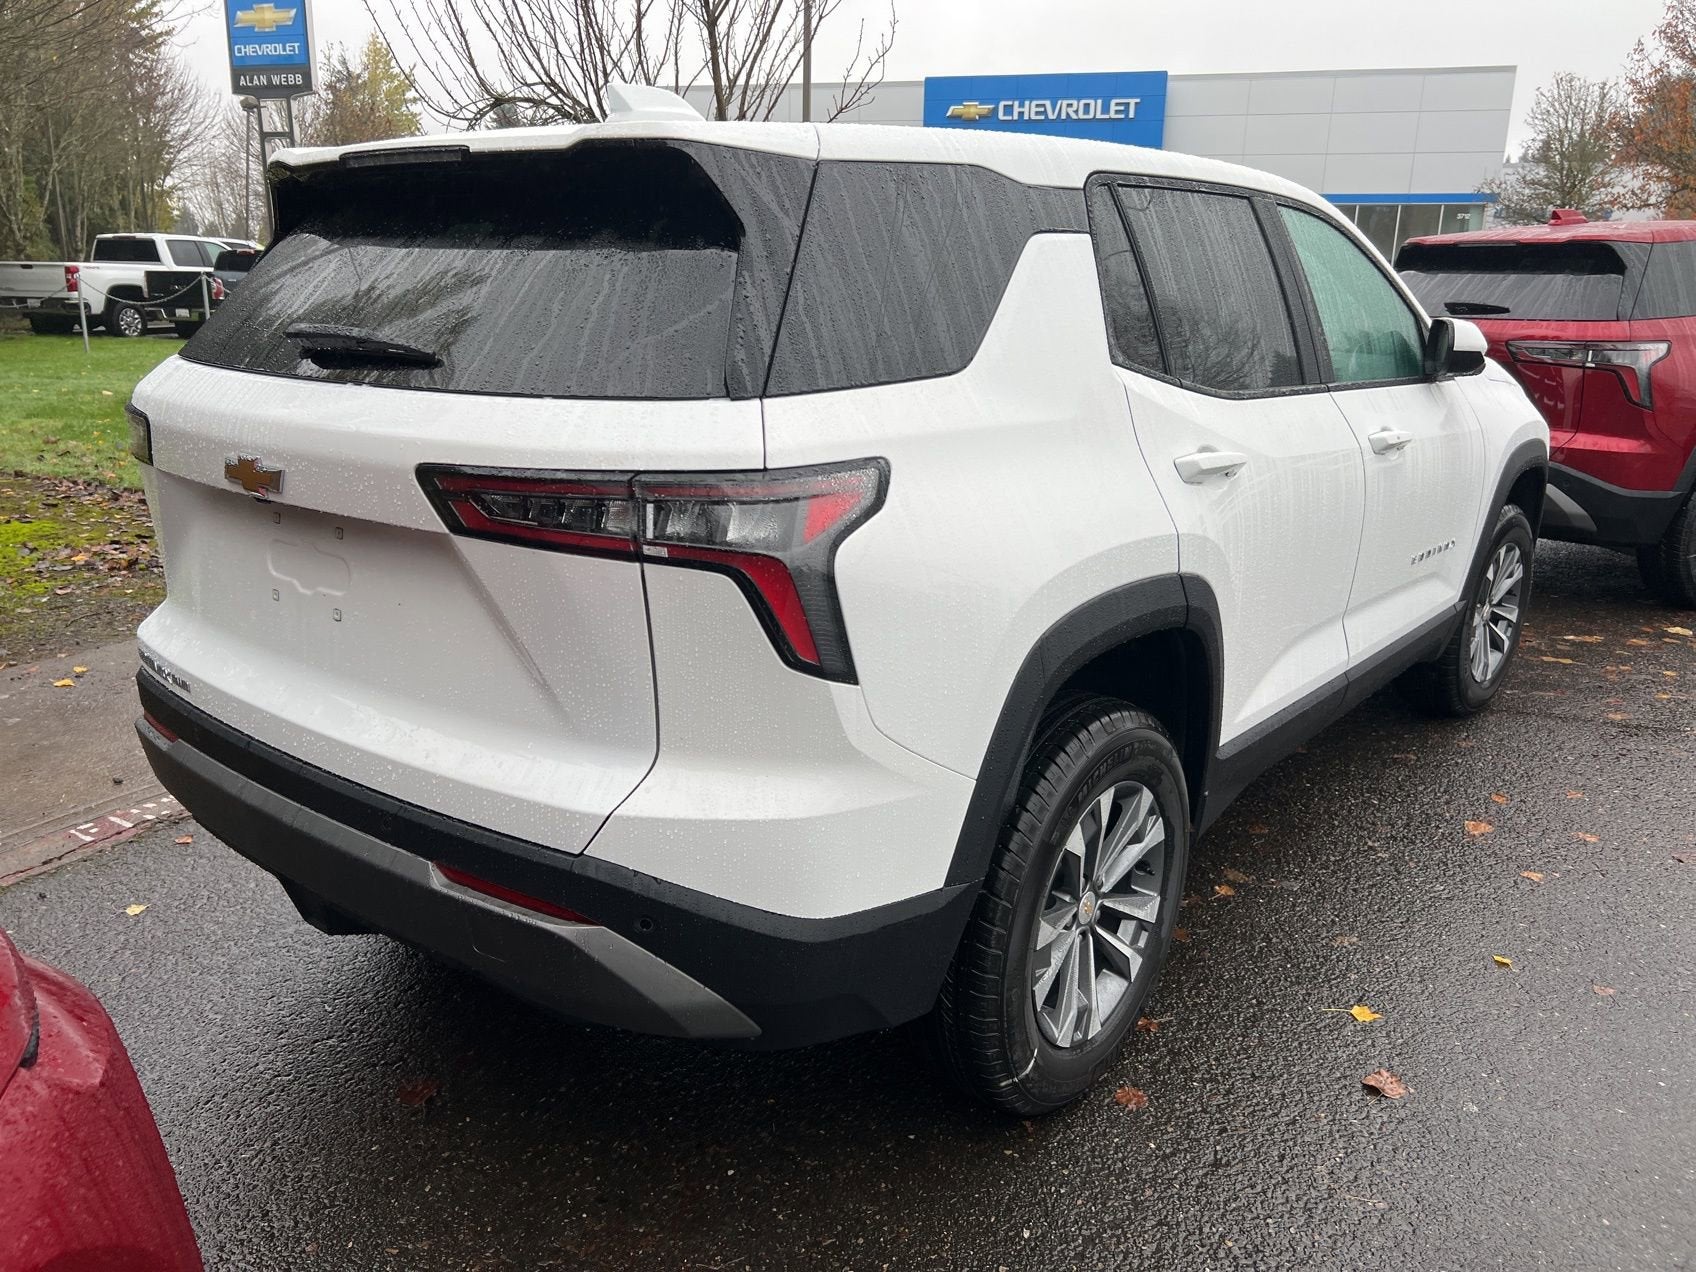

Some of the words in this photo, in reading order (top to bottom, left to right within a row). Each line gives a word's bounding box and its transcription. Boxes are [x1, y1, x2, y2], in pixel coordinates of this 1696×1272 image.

[234, 43, 300, 56] CHEVROLET
[239, 75, 267, 86] ALAN
[271, 73, 303, 85] WEBB
[997, 98, 1140, 121] CHEVROLET
